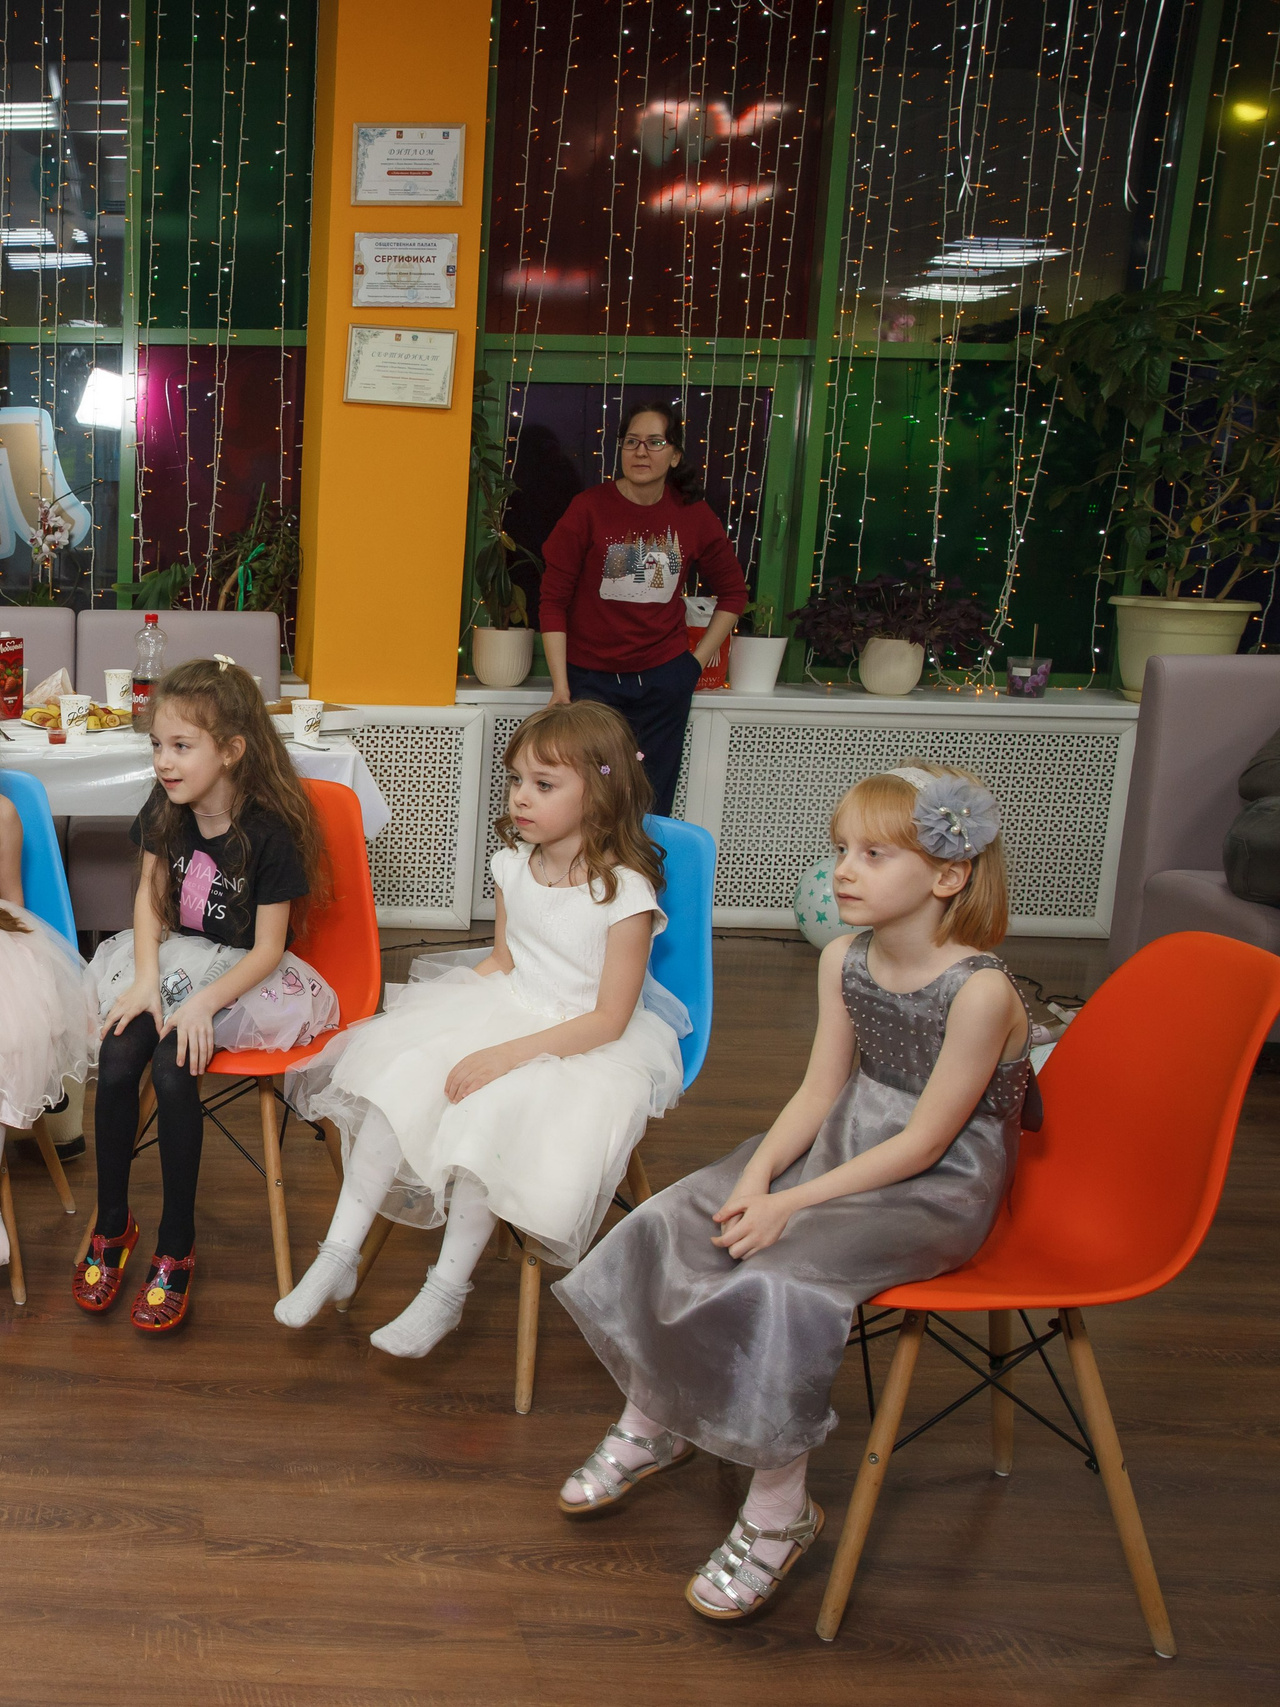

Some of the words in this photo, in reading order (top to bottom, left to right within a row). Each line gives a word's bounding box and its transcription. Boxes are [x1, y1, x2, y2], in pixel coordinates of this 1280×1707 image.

[374, 255, 437, 263] СЕРТИФИКАТ
[371, 351, 440, 361] СЕРТИФИКАТ
[179, 889, 227, 919] WAYS
